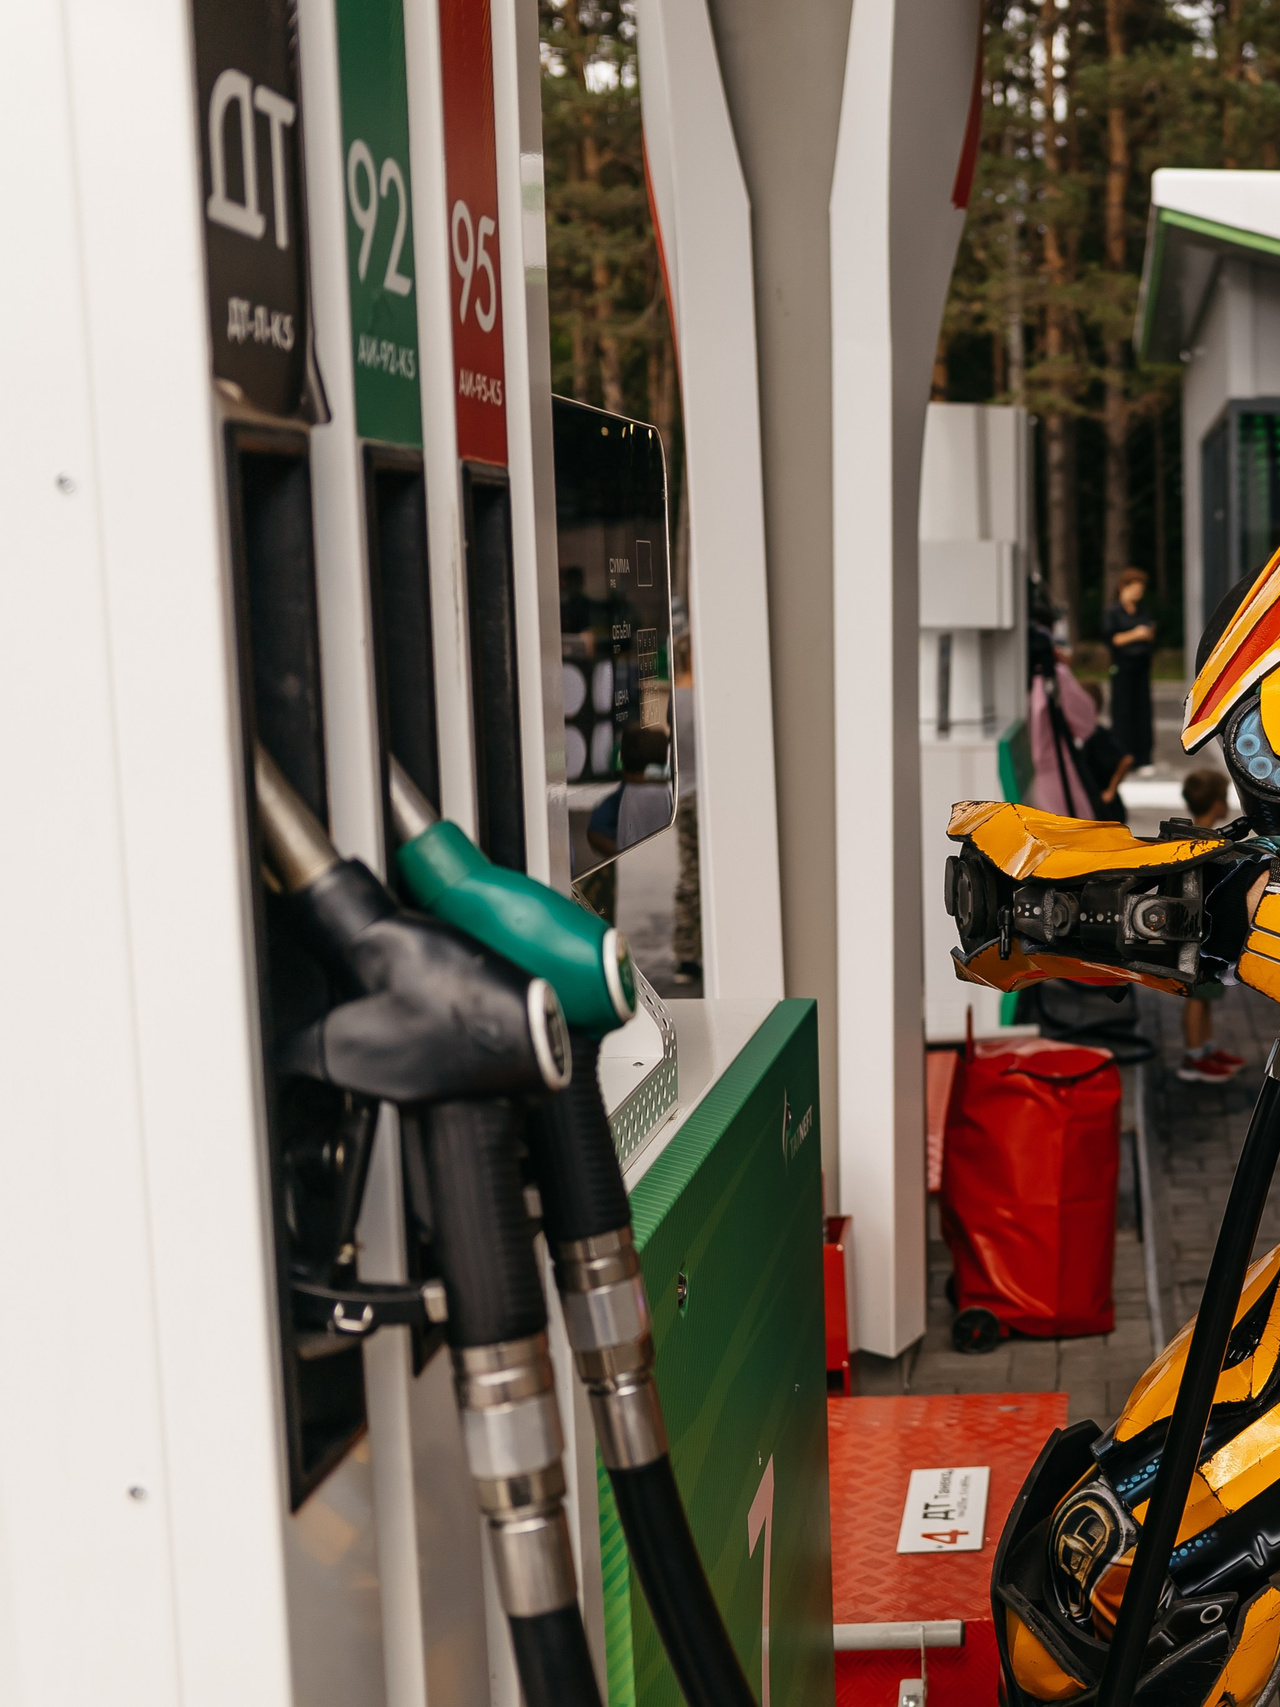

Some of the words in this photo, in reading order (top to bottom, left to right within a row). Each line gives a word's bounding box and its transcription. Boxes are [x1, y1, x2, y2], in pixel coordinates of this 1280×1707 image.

[207, 68, 296, 250] ДТ
[346, 138, 412, 297] 92
[451, 199, 497, 333] 95
[921, 1528, 969, 1545] 4
[922, 1502, 956, 1520] ДТ
